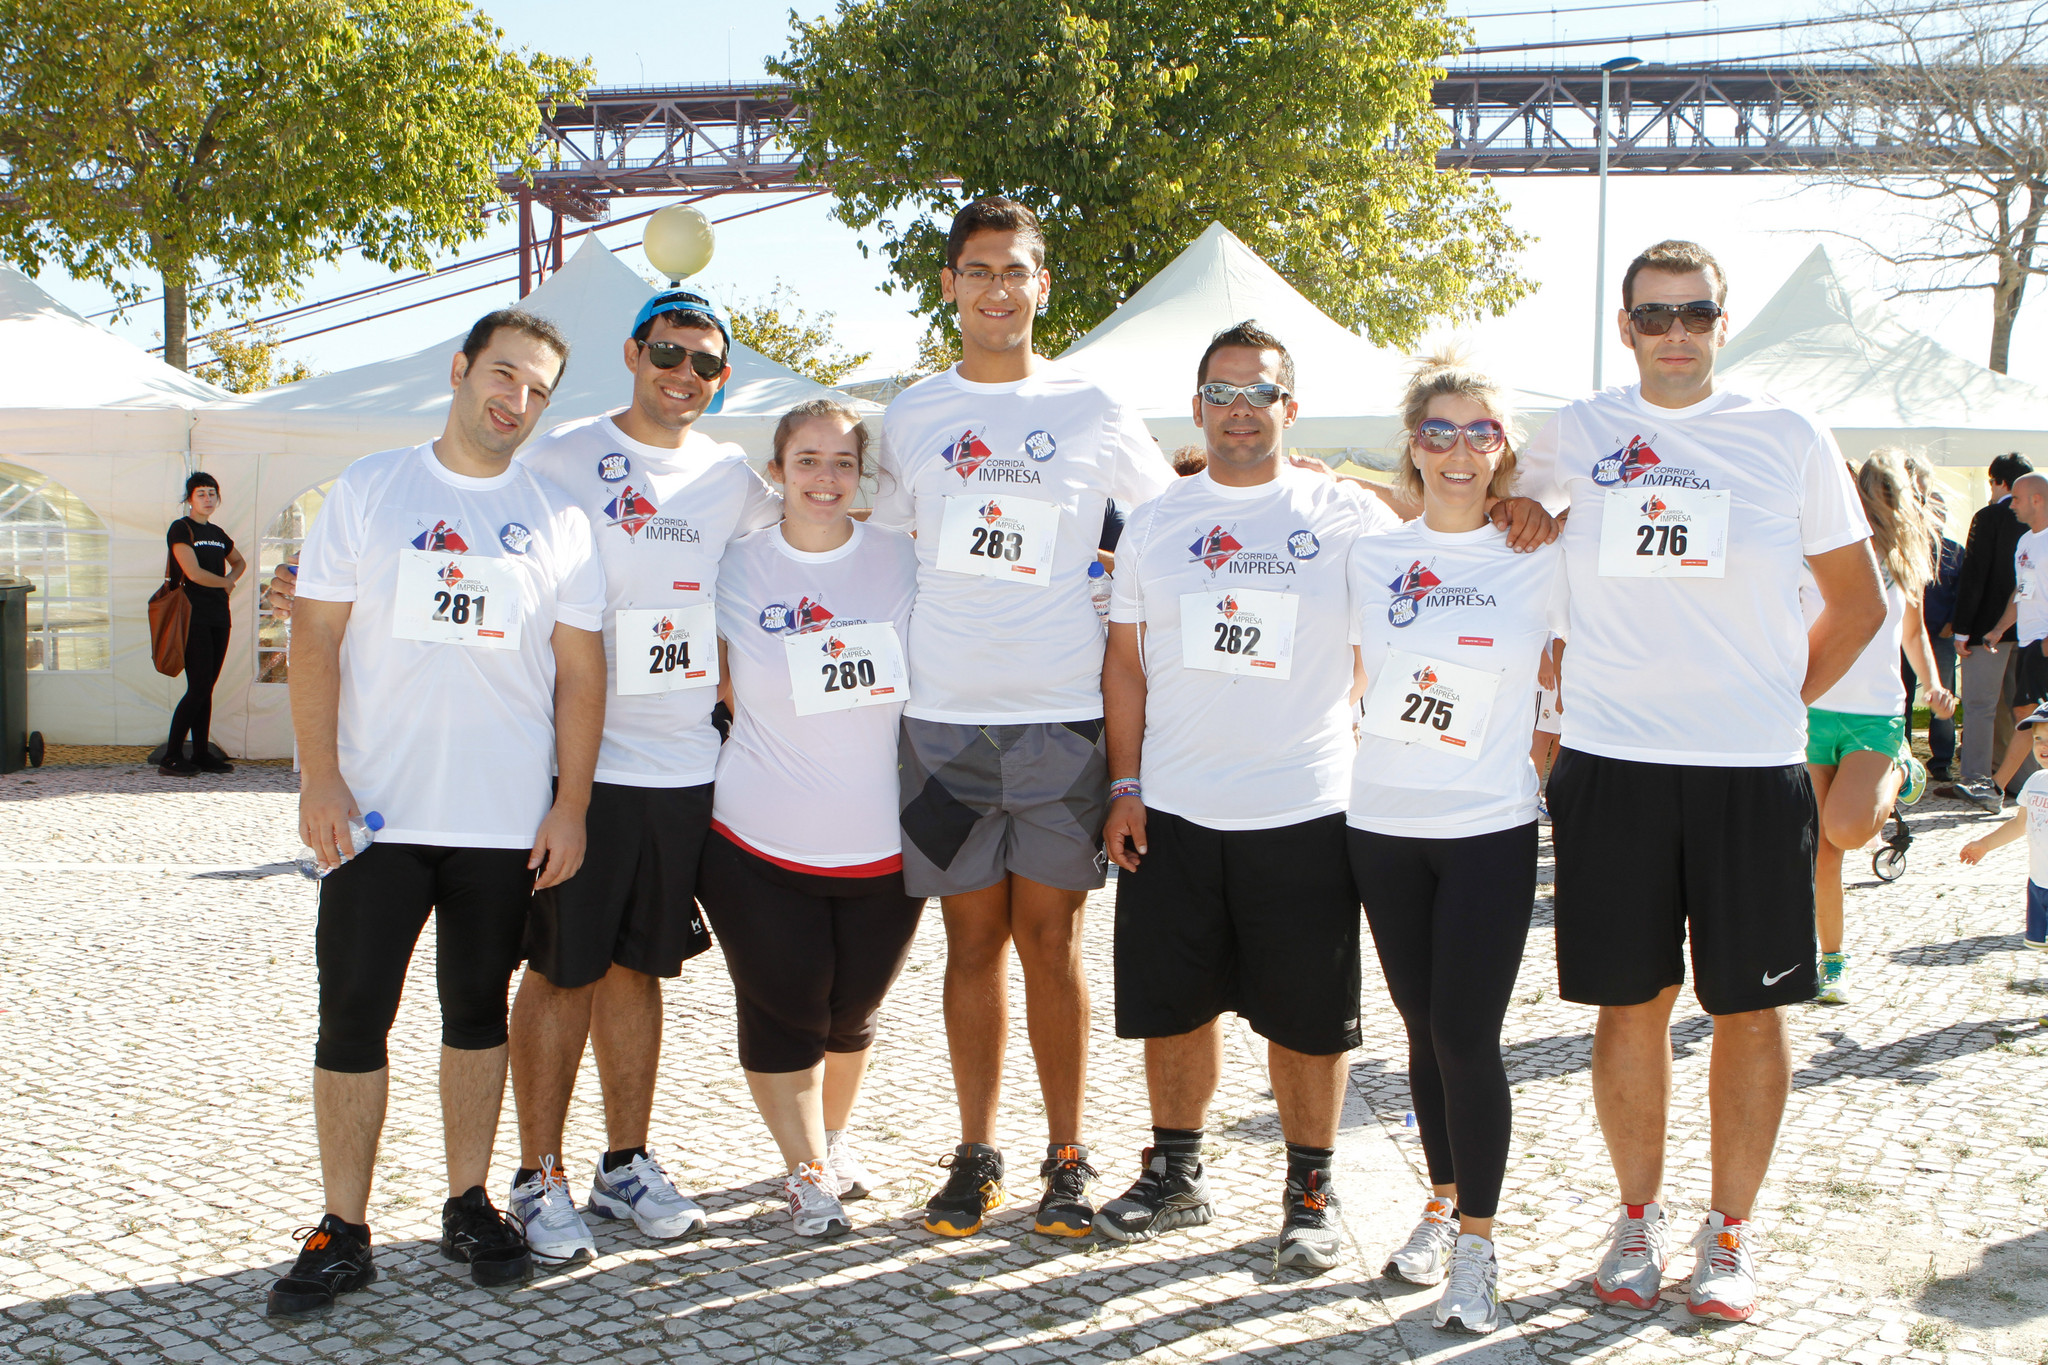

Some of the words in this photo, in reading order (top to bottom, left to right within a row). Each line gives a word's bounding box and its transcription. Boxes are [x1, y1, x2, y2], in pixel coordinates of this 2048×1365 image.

[1025, 432, 1050, 448] PESO
[1033, 444, 1056, 459] PESADO
[601, 456, 627, 468] PESO
[986, 460, 1025, 468] CORRIDA
[1597, 459, 1622, 471] PESO
[602, 466, 628, 480] PESADO
[978, 467, 1041, 484] IMPRESA
[1594, 470, 1620, 482] PESADO
[1653, 466, 1696, 476] CORRIDA
[1642, 474, 1711, 490] IMPRESA
[653, 517, 688, 527] CORRIDA
[1660, 514, 1692, 522] IMPRESA
[995, 520, 1026, 532] IMPRESA
[646, 525, 701, 544] IMPRESA
[1289, 532, 1314, 546] PESO
[1636, 524, 1688, 556] 276
[969, 526, 1023, 562] 283
[1294, 545, 1319, 557] PESADO
[1237, 552, 1279, 560] CORRIDA
[1228, 560, 1296, 575] IMPRESA
[456, 583, 490, 593] IMPRESA
[1434, 586, 1478, 594] CORRIDA
[1390, 598, 1414, 614] PESO
[1425, 594, 1498, 608] IMPRESA
[431, 591, 486, 626] 281
[763, 606, 787, 618] PESO
[762, 618, 787, 629] PESADO
[829, 619, 868, 628] CORRIDA
[1232, 615, 1263, 625] IMPRESA
[1392, 609, 1416, 625] PESADO
[1213, 622, 1261, 657] 282
[648, 641, 691, 675] 284
[841, 649, 872, 660] IMPRESA
[821, 659, 876, 693] 280
[1429, 687, 1461, 702] IMPRESA
[1400, 692, 1455, 732] 275
